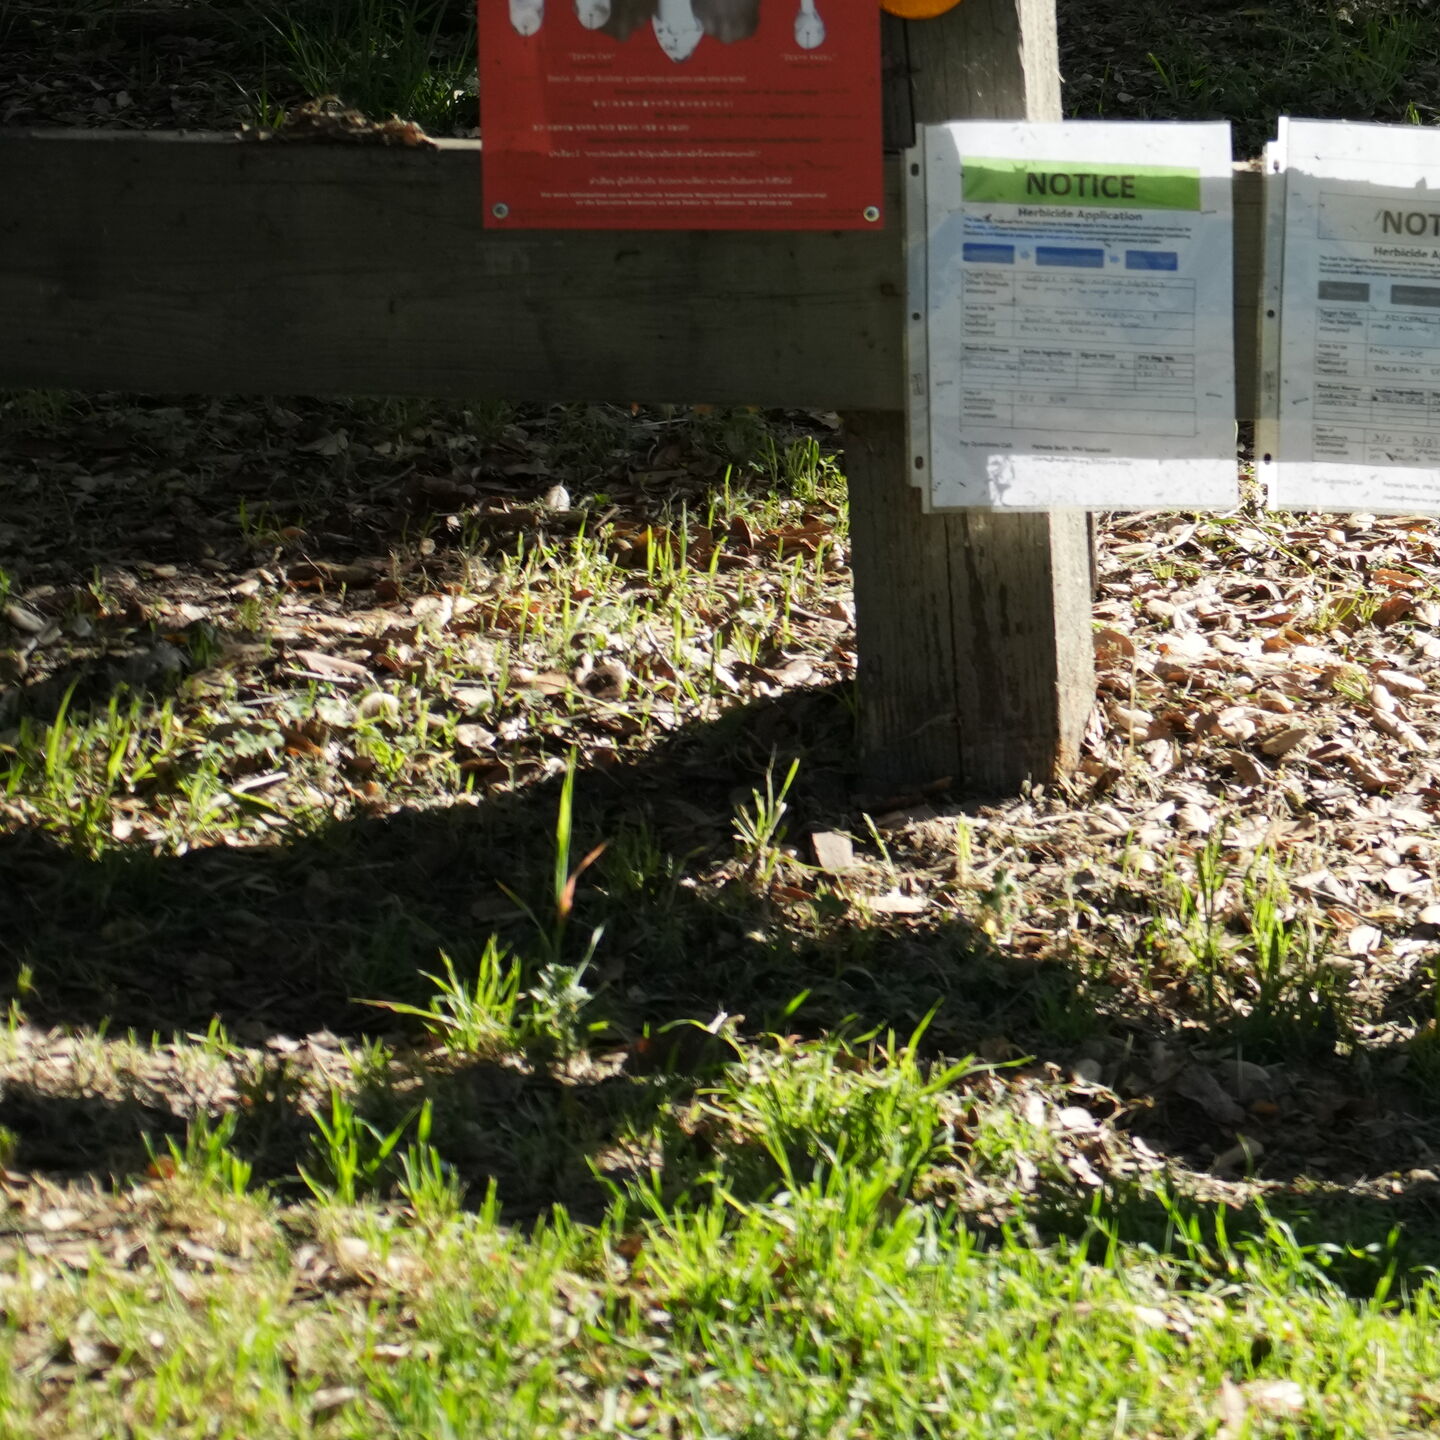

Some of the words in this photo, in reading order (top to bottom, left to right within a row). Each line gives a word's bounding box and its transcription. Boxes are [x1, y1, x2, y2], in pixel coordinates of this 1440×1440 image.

[1026, 172, 1135, 198] NOTICE
[1018, 207, 1073, 219] Herbicide
[1078, 210, 1142, 223] Application
[1374, 246, 1427, 259] Herbicide
